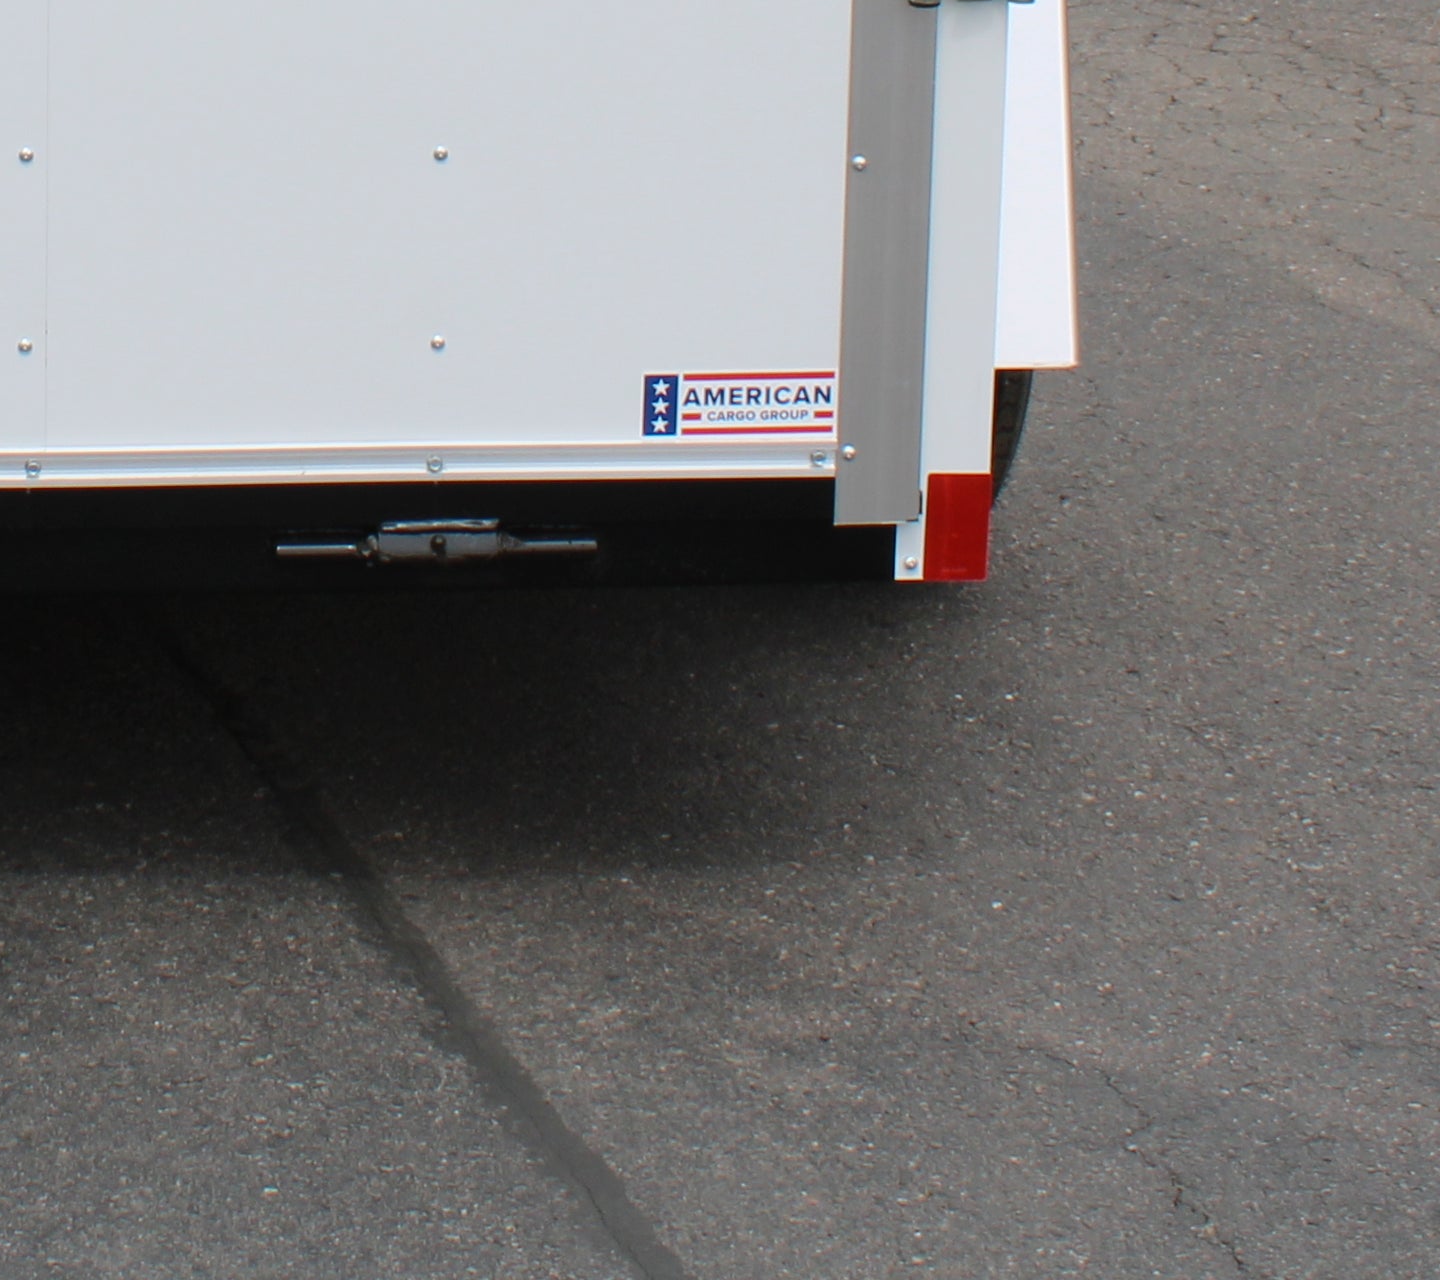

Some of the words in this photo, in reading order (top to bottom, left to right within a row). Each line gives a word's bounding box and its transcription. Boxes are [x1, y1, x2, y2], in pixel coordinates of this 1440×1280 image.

[683, 385, 832, 407] AMERICAN
[706, 410, 756, 422] CARGO
[759, 408, 809, 421] GROUP
